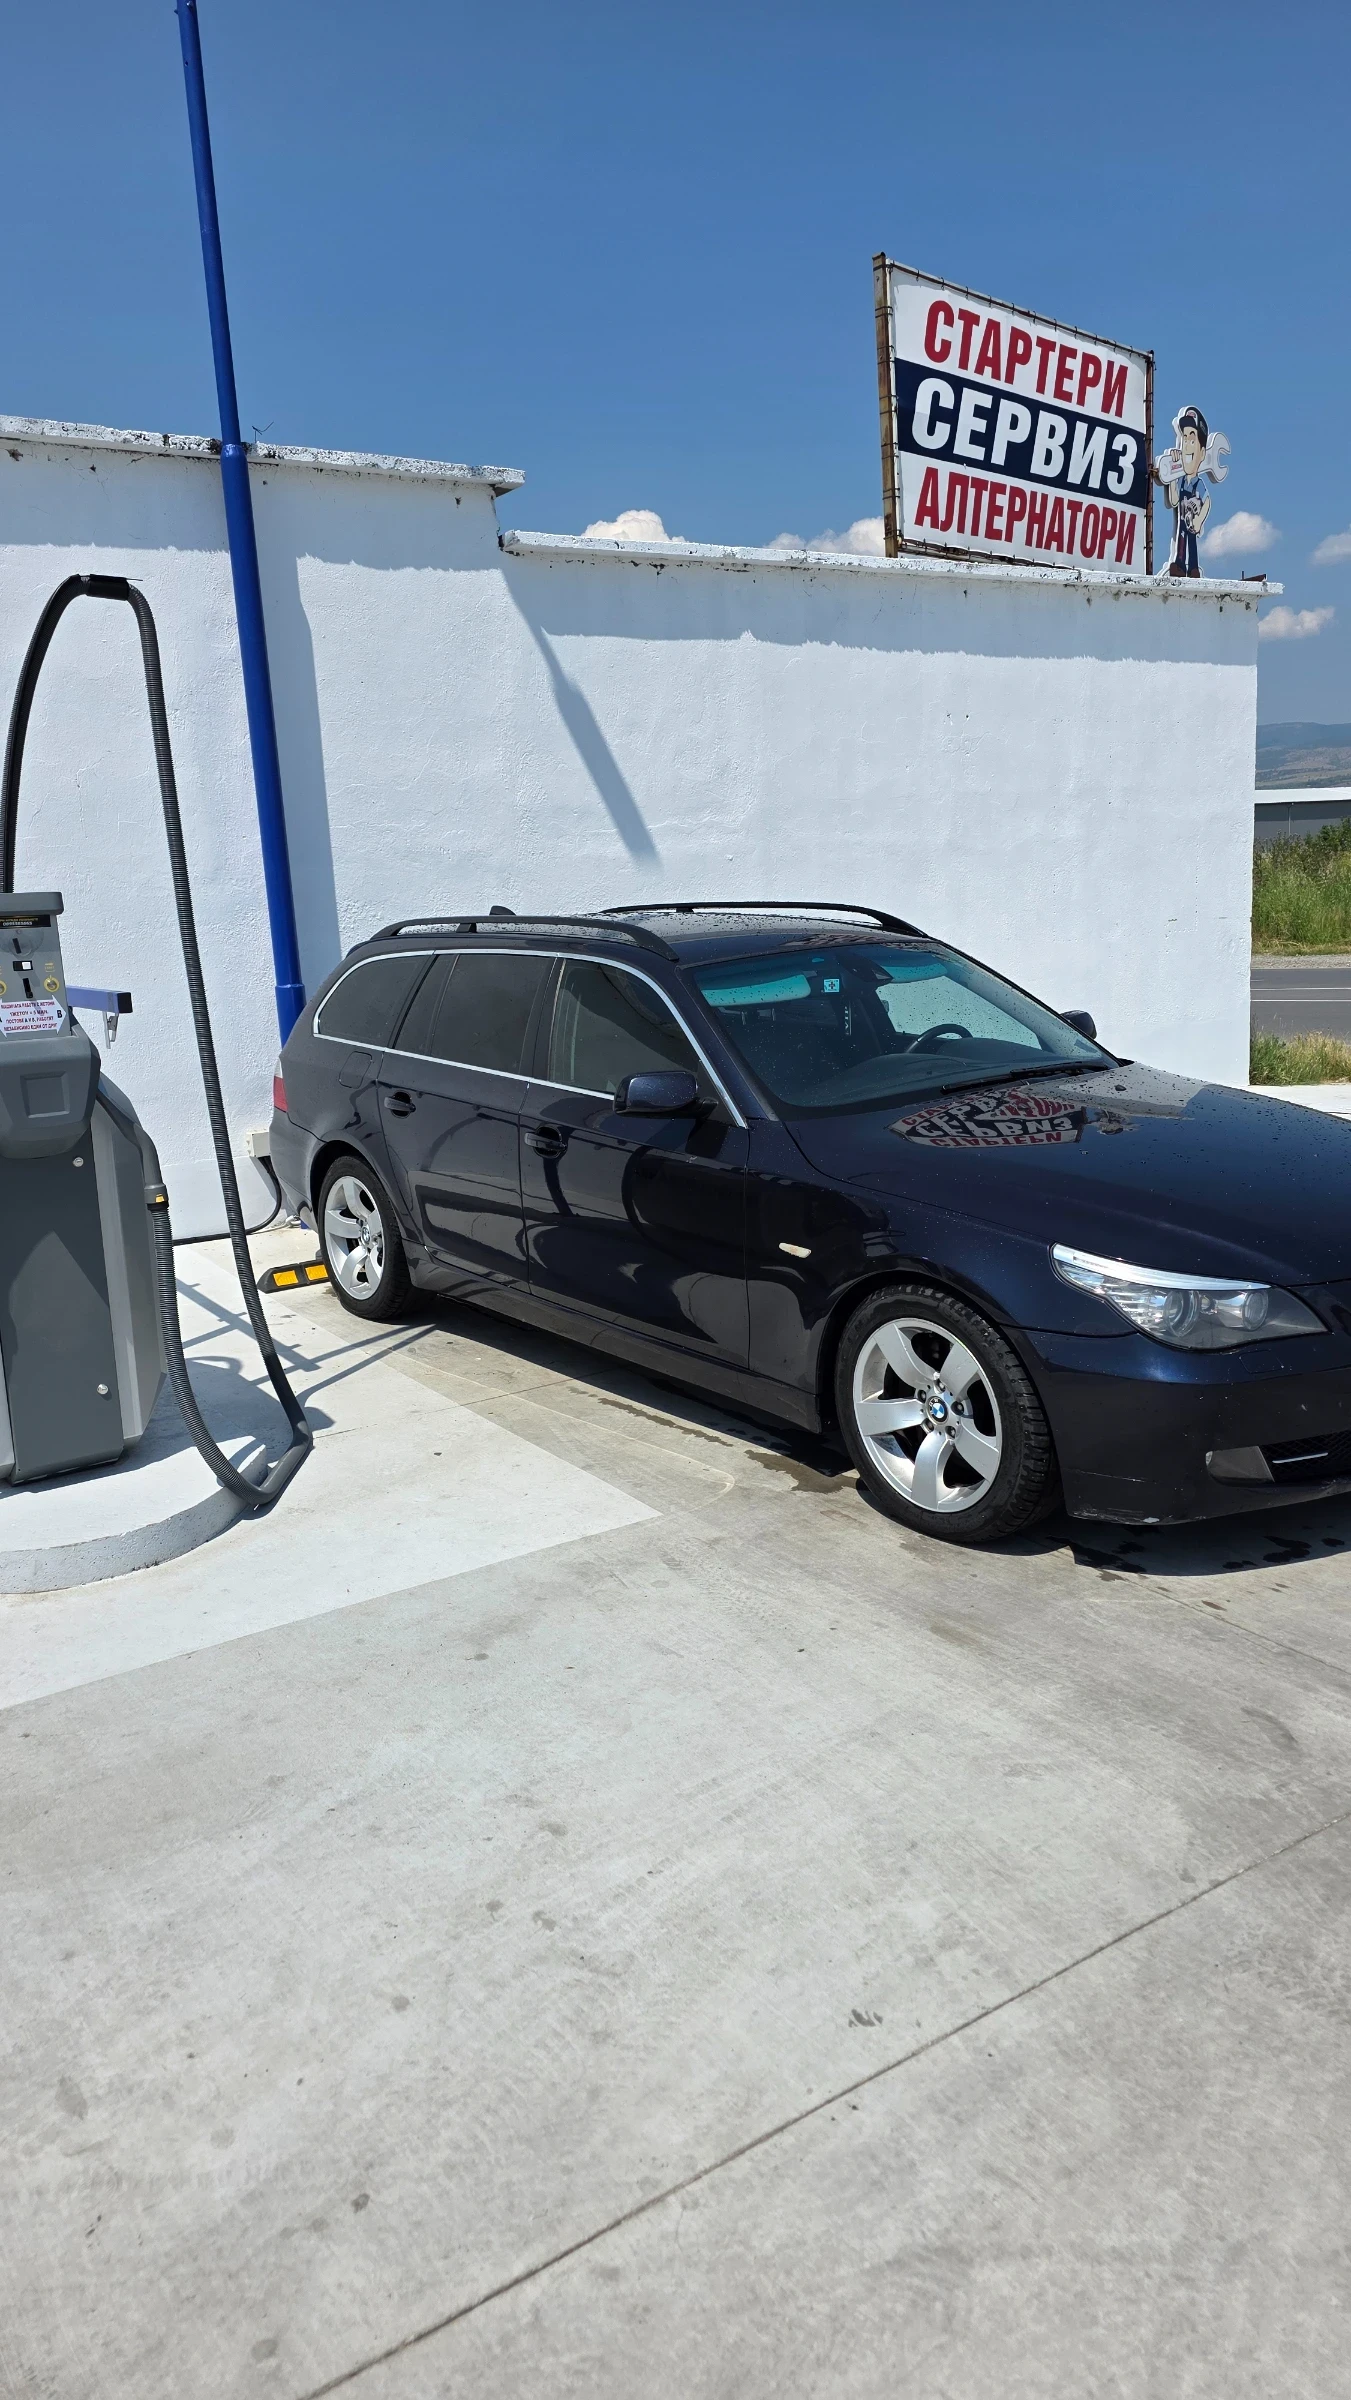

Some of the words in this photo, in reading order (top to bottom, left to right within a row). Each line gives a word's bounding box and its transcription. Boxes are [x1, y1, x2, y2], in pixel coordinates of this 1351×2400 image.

[924, 300, 1128, 418] СТАРТЕРИ
[911, 377, 1138, 495] СЕРВИЗ
[915, 466, 1137, 565] АЛТЕРНАТОРИ
